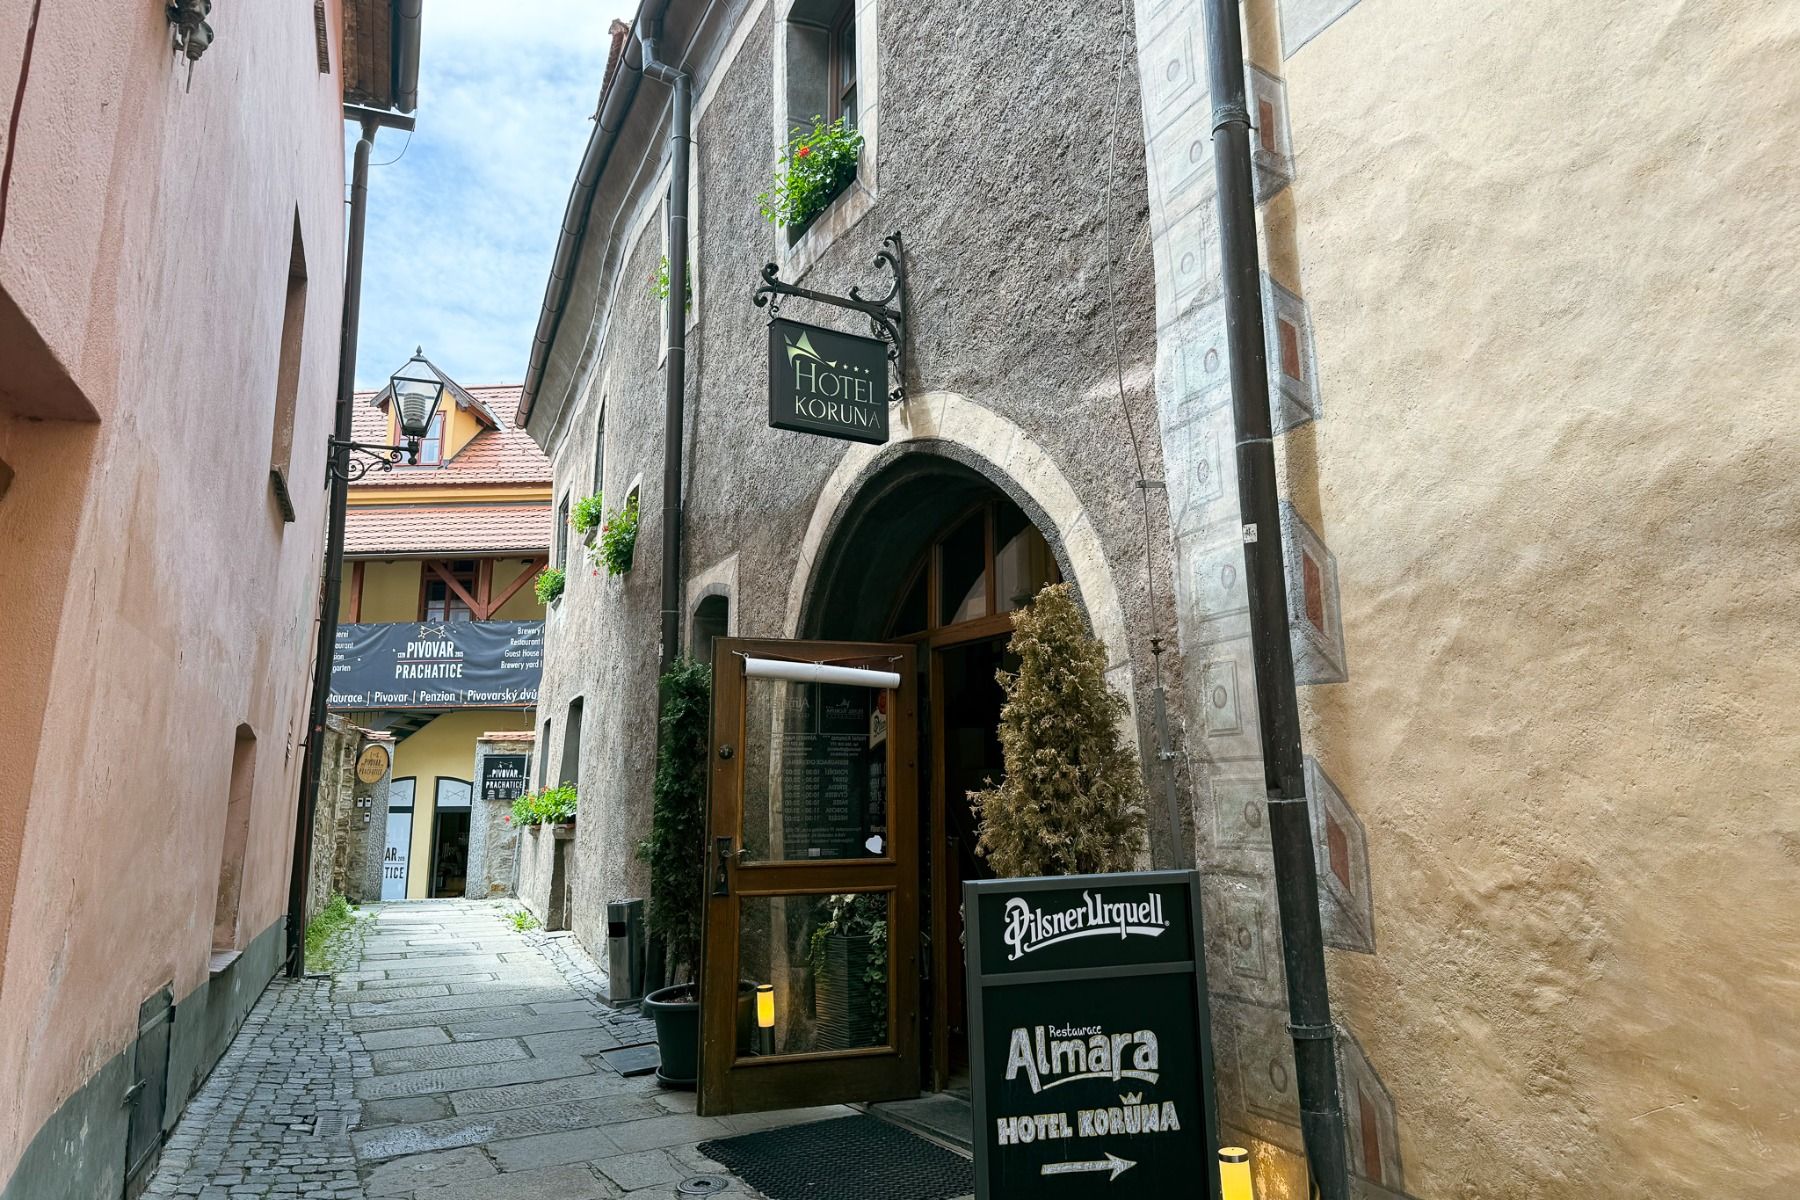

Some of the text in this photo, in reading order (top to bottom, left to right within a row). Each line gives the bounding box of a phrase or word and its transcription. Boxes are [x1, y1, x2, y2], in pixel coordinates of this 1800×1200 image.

[795, 359, 881, 406] HOTEL
[795, 394, 881, 429] KORUNA
[517, 626, 540, 637] Brewery
[406, 640, 454, 658] PIVOVAR
[510, 637, 541, 646] Restaurant
[504, 649, 521, 658] Guest
[395, 663, 463, 679] PRACHATICE
[500, 658, 540, 671] Brewery yard
[374, 691, 409, 703] Pivovar
[420, 690, 456, 702] Penzion
[467, 687, 518, 703] Pivovarský
[491, 768, 519, 778] PIVOVAR
[485, 780, 523, 789] PRACHATICE
[384, 847, 398, 862] AR
[384, 866, 405, 879] TICE
[1003, 889, 1164, 961] Pilsner Urquell
[1048, 1022, 1103, 1038] Restaurace
[1004, 1025, 1160, 1095] Almara
[996, 1100, 1181, 1146] HOTEL KORUNA
